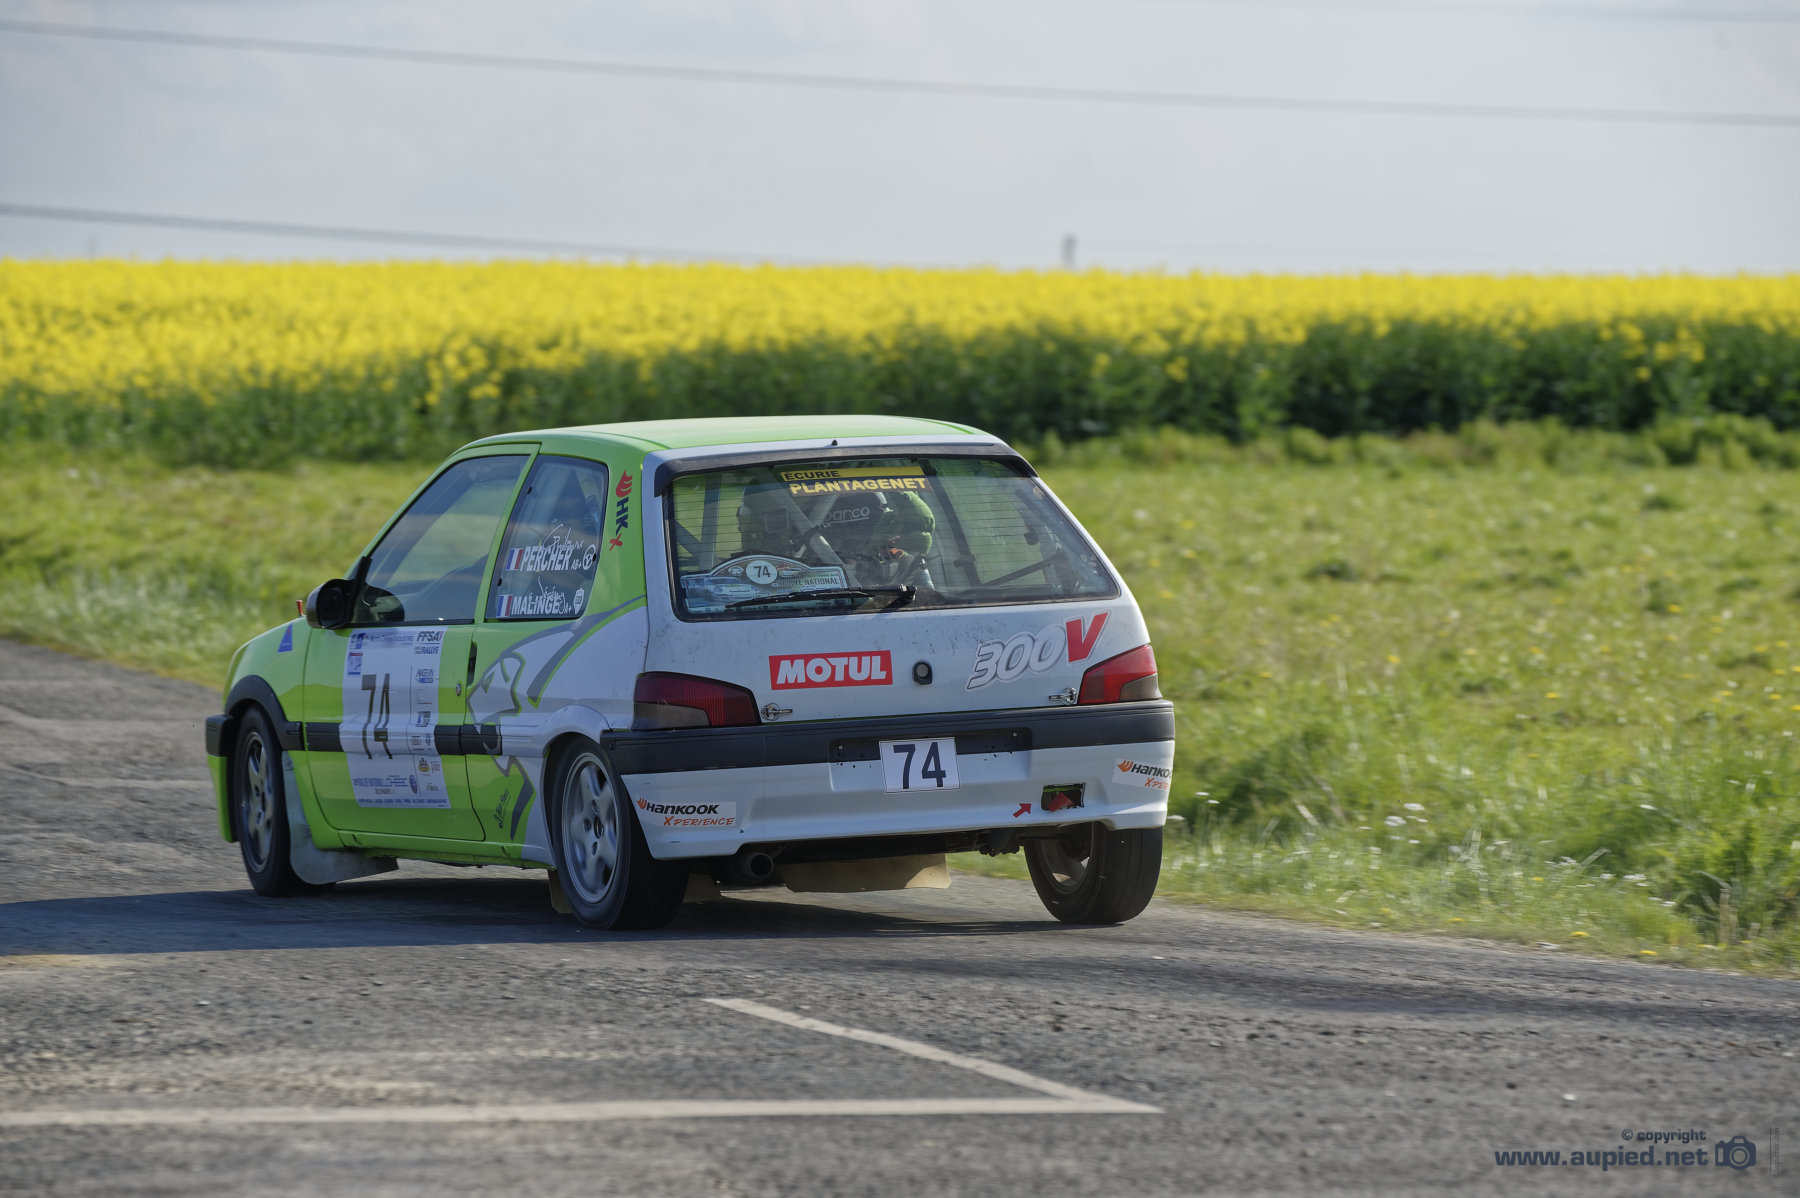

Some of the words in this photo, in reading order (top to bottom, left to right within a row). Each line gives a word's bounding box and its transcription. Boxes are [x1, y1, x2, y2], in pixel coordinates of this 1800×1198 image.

[784, 470, 840, 481] ECURIE
[789, 477, 926, 495] PLANTAGENET
[824, 506, 870, 521] parco
[520, 546, 573, 572] PERCHER
[753, 565, 771, 579] 74
[511, 595, 559, 614] MALINGE
[966, 611, 1110, 690] 300V
[776, 655, 887, 685] MOTUL
[360, 672, 393, 760] 74
[892, 741, 947, 790] 74
[1131, 763, 1170, 778] Hanko
[646, 802, 720, 815] Hankook
